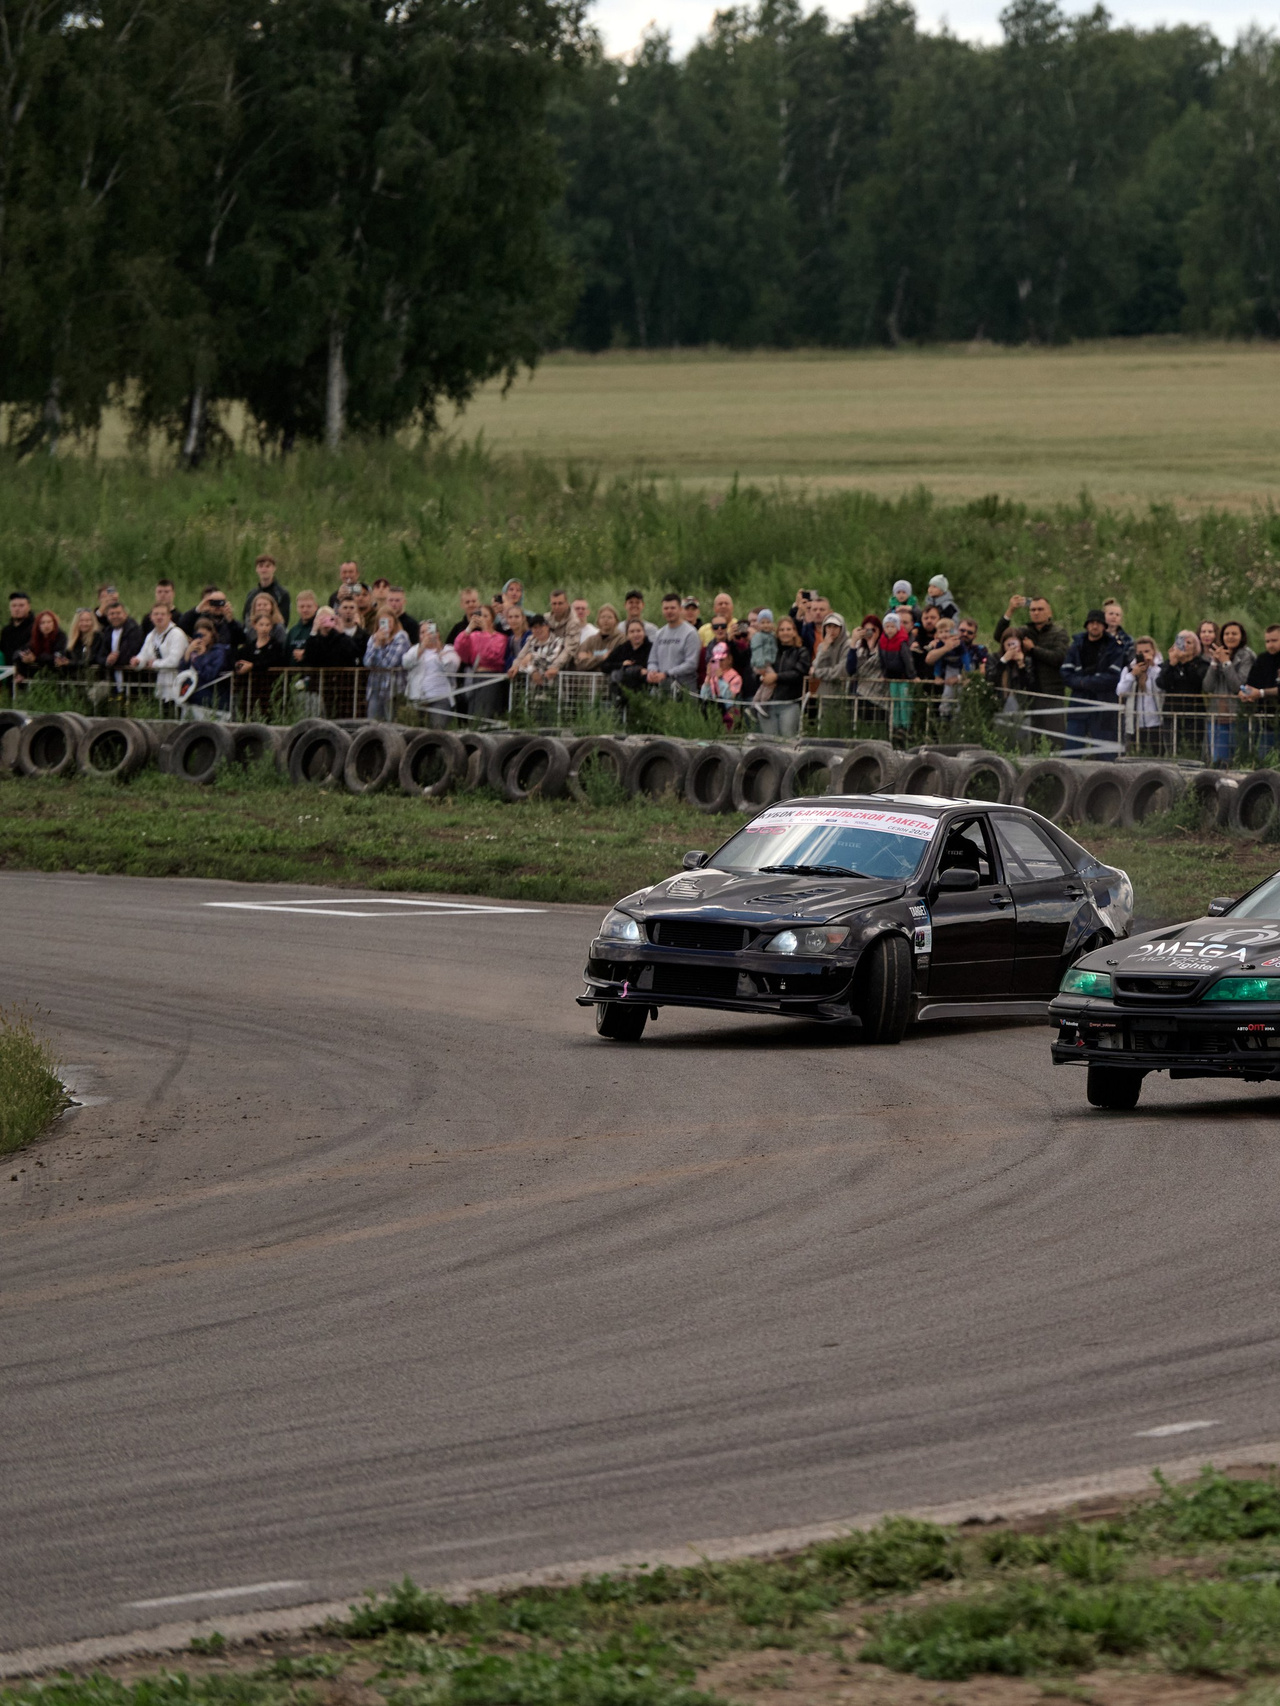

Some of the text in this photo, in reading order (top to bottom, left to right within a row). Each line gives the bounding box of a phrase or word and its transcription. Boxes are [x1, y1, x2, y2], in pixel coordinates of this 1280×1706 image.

[758, 810, 796, 819] КУБОК
[795, 810, 886, 821] БАРНАУЛЬСКОЙ
[886, 816, 935, 830] РАКЕТЫ
[887, 825, 931, 837] СЕЗОН 2025
[1128, 941, 1247, 962] OMEGA
[1168, 961, 1219, 971] Fighter
